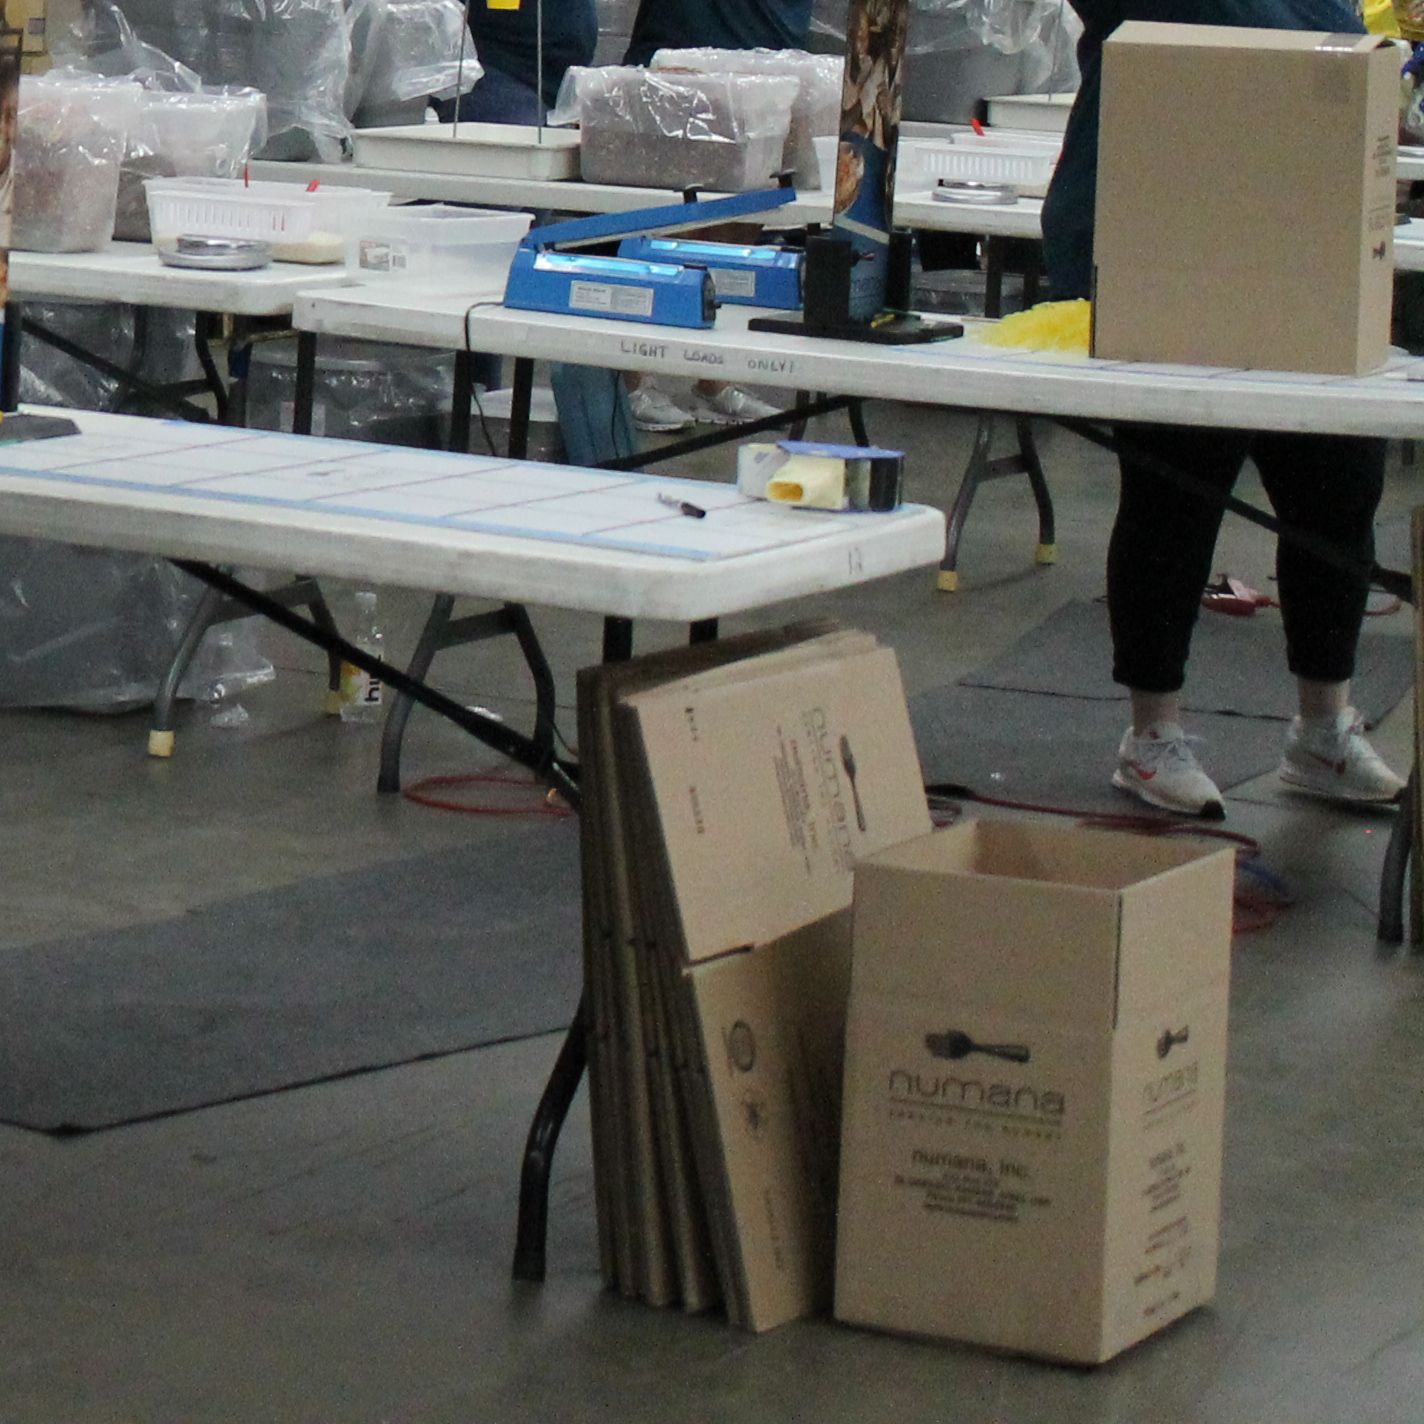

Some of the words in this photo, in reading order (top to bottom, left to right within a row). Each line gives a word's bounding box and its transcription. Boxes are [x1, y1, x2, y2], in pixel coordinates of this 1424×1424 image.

[620, 340, 669, 359] LIGHT
[683, 349, 724, 365] LOADS
[748, 359, 795, 374] ONLY!
[889, 1070, 1065, 1115] numana
[912, 1149, 992, 1174] numana,
